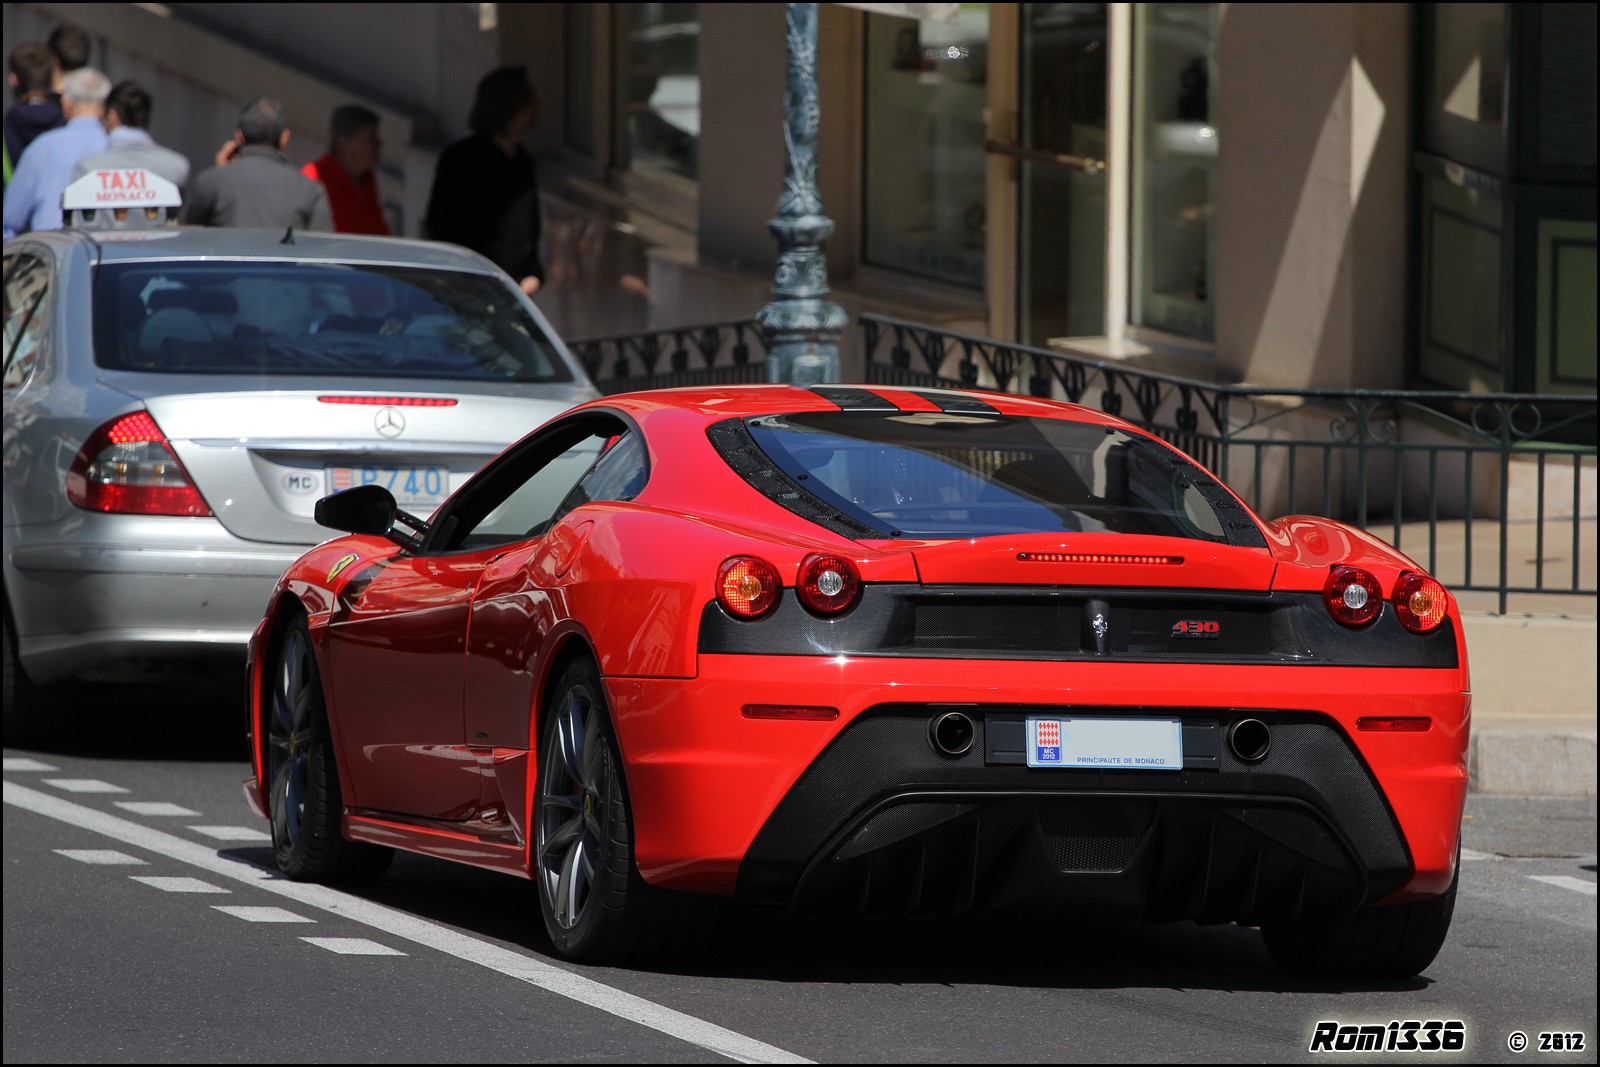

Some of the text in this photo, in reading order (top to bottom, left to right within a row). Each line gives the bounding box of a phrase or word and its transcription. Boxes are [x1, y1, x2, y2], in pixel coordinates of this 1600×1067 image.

[96, 170, 146, 190] TAXI
[96, 190, 156, 201] MONACO
[288, 477, 311, 489] MC
[1172, 620, 1220, 633] 430
